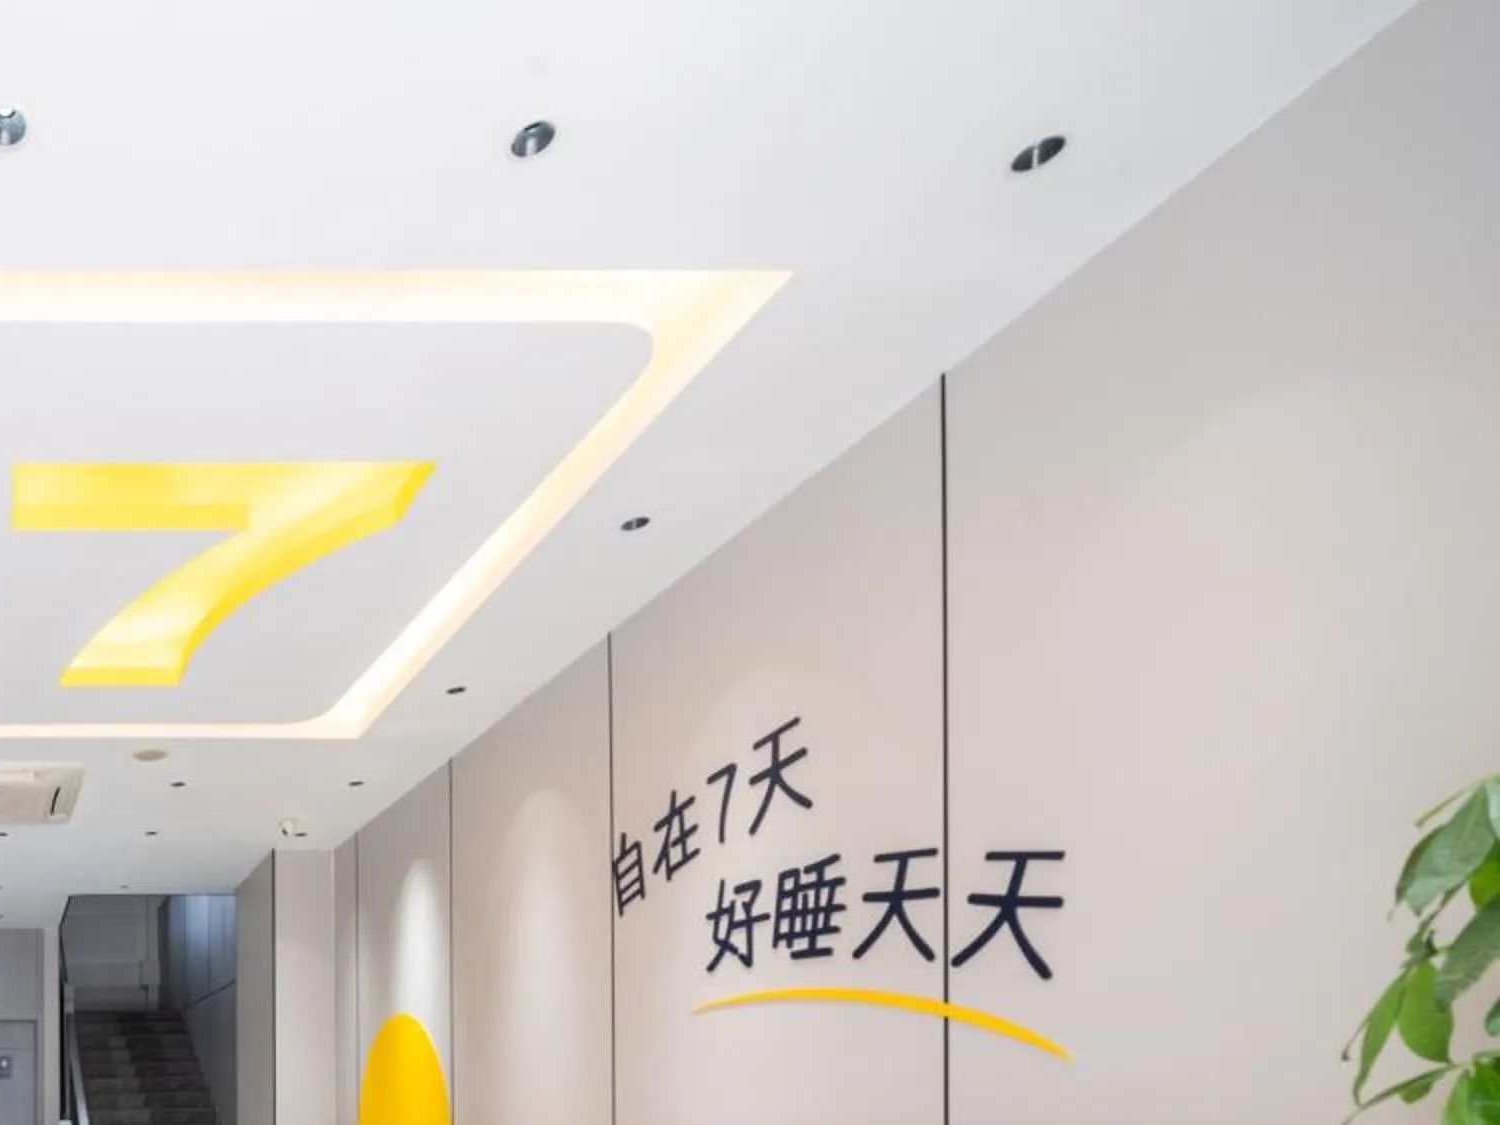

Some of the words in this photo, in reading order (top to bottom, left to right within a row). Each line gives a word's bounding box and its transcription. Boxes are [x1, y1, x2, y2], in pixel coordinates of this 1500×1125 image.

[10, 460, 437, 686] 7
[612, 716, 813, 917] 自在7天
[705, 847, 1065, 981] 好睡天天
